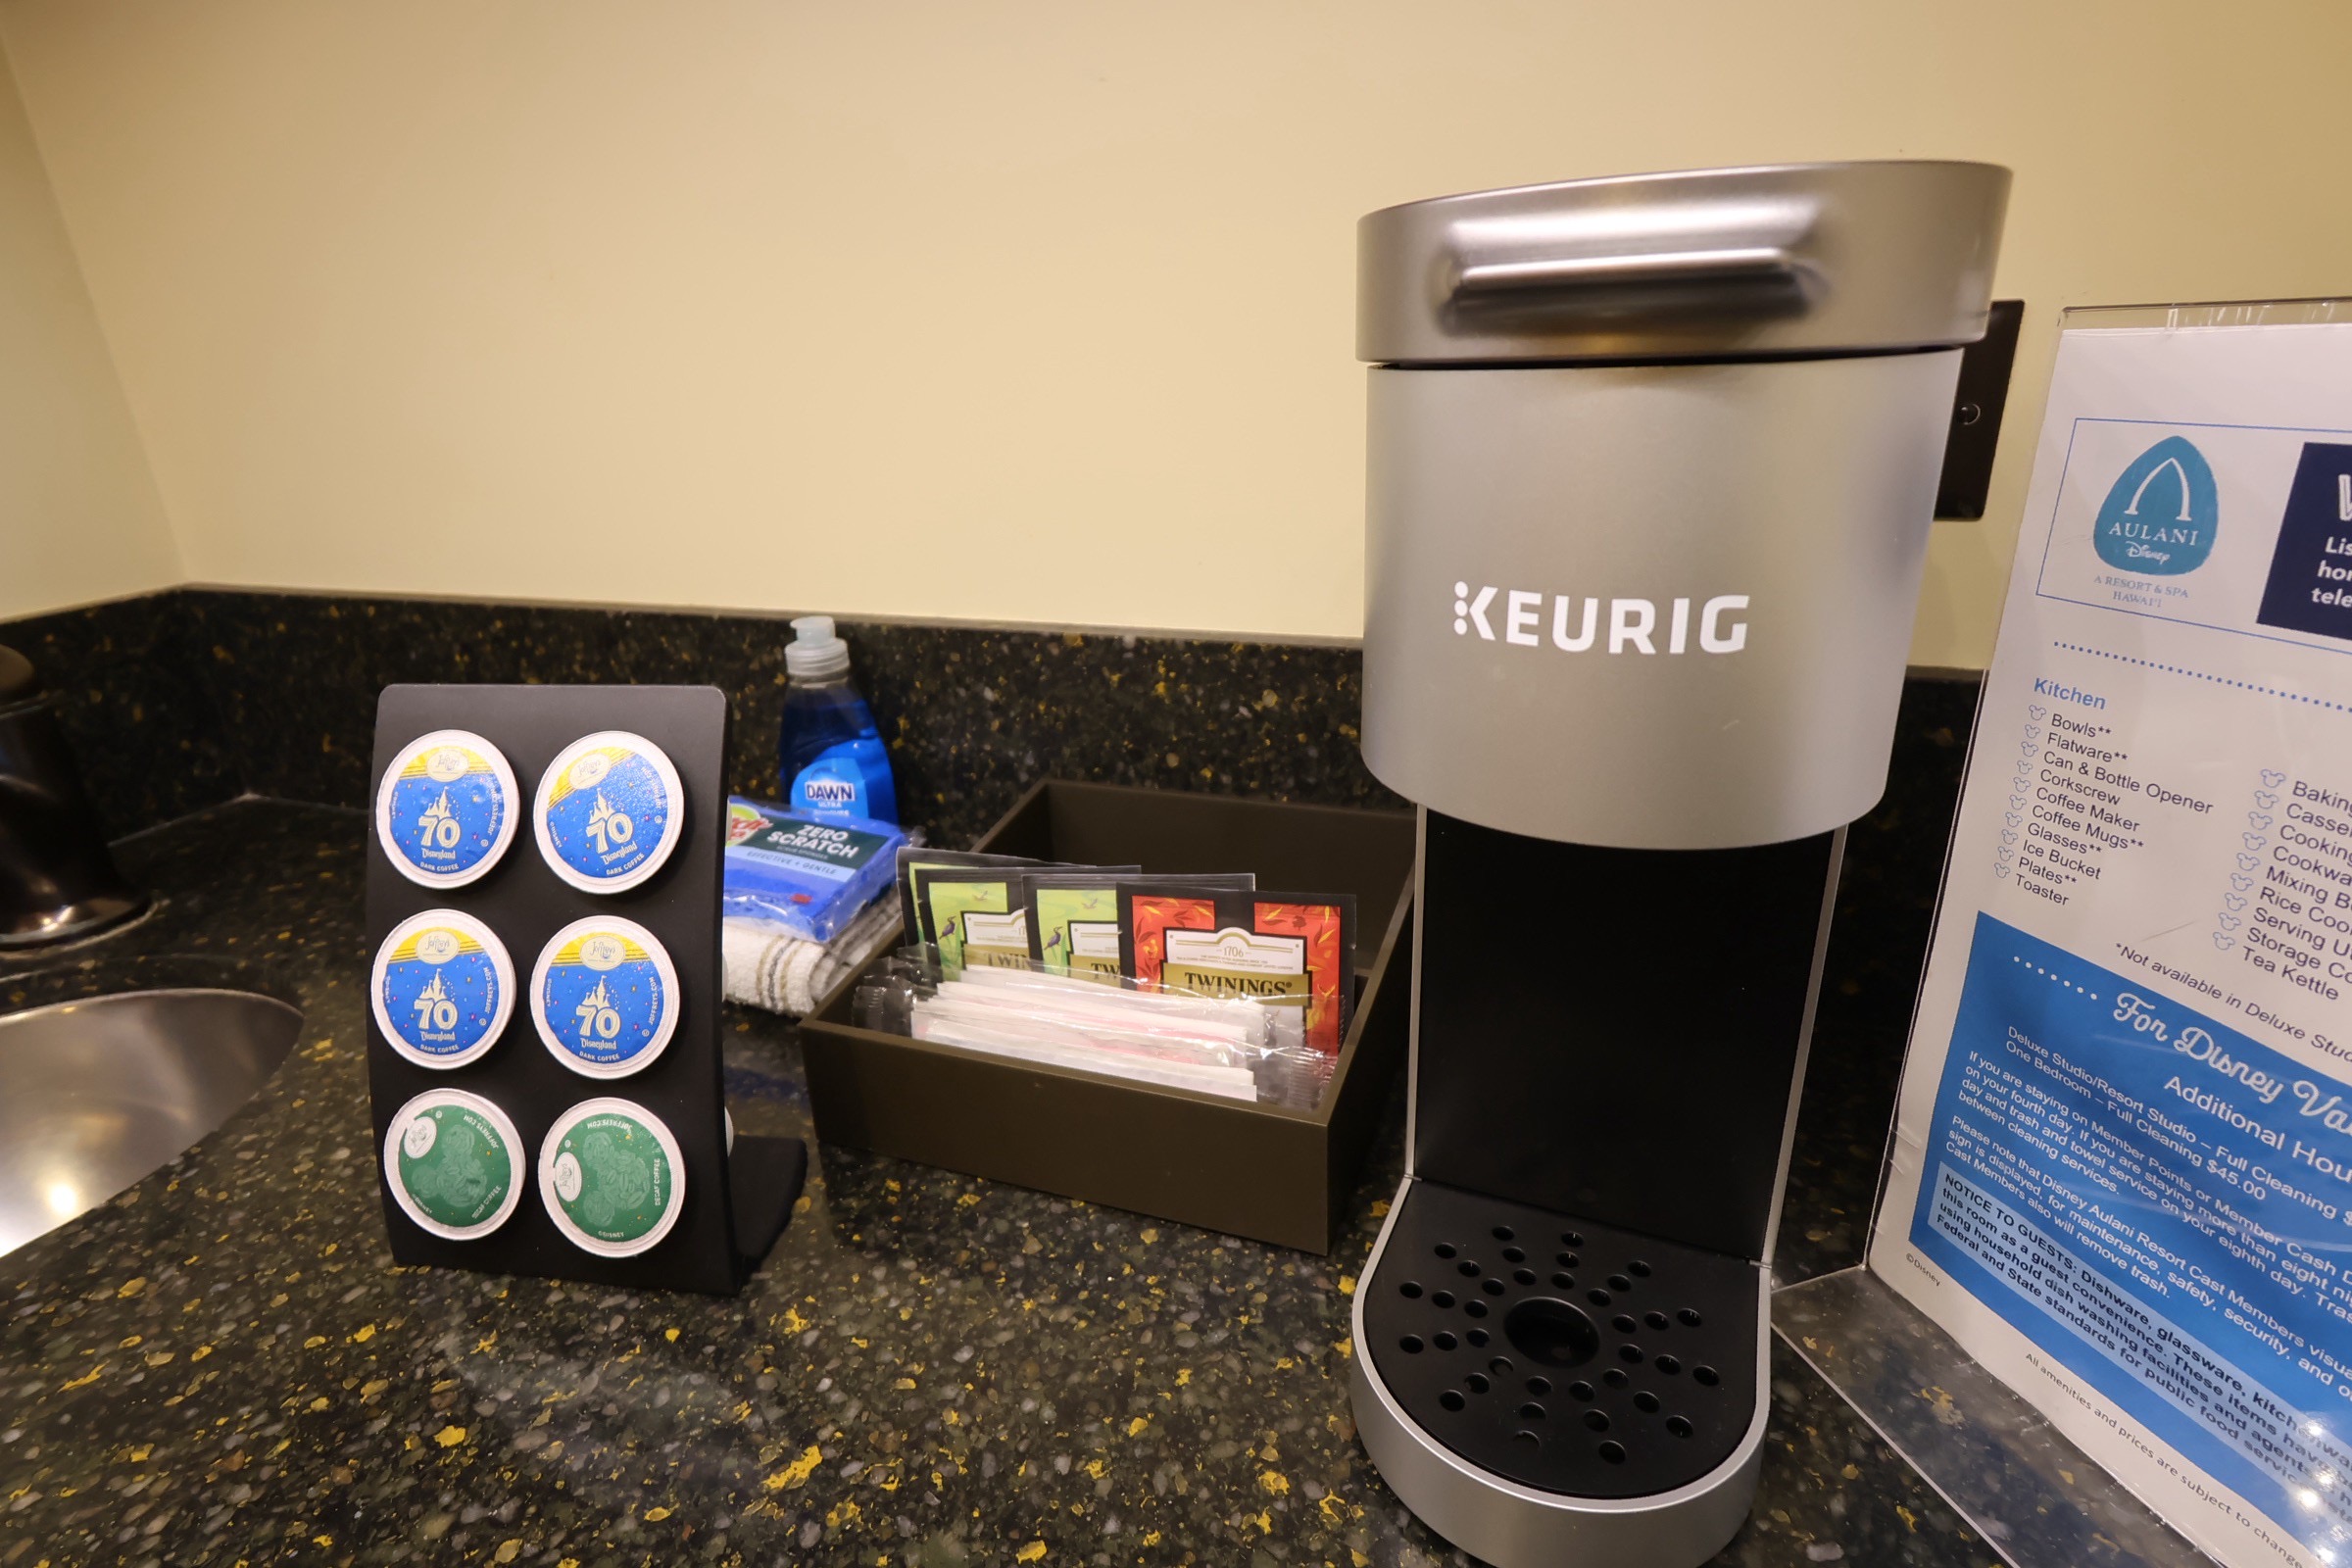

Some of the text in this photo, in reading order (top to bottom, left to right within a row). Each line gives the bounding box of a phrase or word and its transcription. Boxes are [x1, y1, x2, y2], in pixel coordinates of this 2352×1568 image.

[2109, 522, 2199, 546] AULANI
[2126, 541, 2170, 564] Disney
[2105, 576, 2152, 592] RESORT
[2154, 585, 2162, 594] &
[2166, 586, 2188, 598] SPA
[1454, 580, 1750, 655] KEURIG
[2034, 678, 2106, 710] Kitchen
[807, 784, 853, 800] DAWN
[2040, 769, 2121, 806] Corkscrew
[2044, 751, 2214, 813] Can & Bottle Opener
[2033, 805, 2081, 831] Coffee
[2036, 787, 2140, 832] Coffee Maker
[418, 815, 461, 849] 70
[586, 812, 633, 854] 70
[766, 831, 859, 858] SCRATCH
[796, 824, 849, 842] ZERO
[419, 862, 459, 872] DARK COFFEE
[421, 848, 457, 860] Disneyland
[600, 841, 637, 864] Disneyland
[623, 853, 645, 869] COFFEE
[747, 851, 792, 865] EFFECTIVE
[803, 862, 837, 874] GENTLE
[2023, 840, 2101, 880] Ice Bucket
[2016, 873, 2070, 906] Toaster
[2260, 886, 2301, 913] Rice
[2266, 866, 2328, 904] Mixing
[2254, 907, 2326, 951] Serving
[1223, 946, 1244, 957] 1706
[2247, 927, 2321, 969] Storage
[2243, 945, 2338, 1000] Tea Kettle
[414, 999, 459, 1030] 70
[2151, 960, 2222, 999] available
[2225, 994, 2241, 1008] in
[2244, 1003, 2305, 1040] Deluxe
[419, 1031, 456, 1041] Disneyland
[576, 1005, 621, 1039] 70
[438, 1045, 460, 1054] COFFEE
[579, 1051, 596, 1060] DARK
[580, 1038, 616, 1050] Disneyland
[2113, 993, 2168, 1041] For
[2173, 1027, 2283, 1103] Disney
[2006, 1041, 2267, 1200] One Bedroom Full Cleaning $45.00
[2009, 1026, 2337, 1219] Deluxe Studio/Resort Studio Full Cleaning
[2164, 1076, 2285, 1151] Additional
[1958, 1090, 2119, 1195] between cleaning services.
[1978, 1057, 2337, 1276] you are staying on Member Points Member Cash
[1946, 1142, 2170, 1298] Cast Members also will remove trash.
[1952, 1115, 2304, 1348] Please note that Disney Aulani Resort Cast Members
[1948, 1130, 1972, 1150] sign
[2048, 1195, 2066, 1211] for
[2069, 1210, 2161, 1275] maintenance,
[2168, 1271, 2217, 1311] safety,
[2225, 1308, 2290, 1360] security,
[2298, 1358, 2333, 1386] and
[1945, 1174, 2246, 1396] NOTICE TO GUESTS: Dishware, glassware,
[1936, 1214, 2238, 1440] Federal and State standards for public food
[1940, 1202, 2247, 1430] using household dish washing facilities and
[1942, 1188, 1963, 1208] this
[1966, 1206, 1997, 1234] room
[2032, 1252, 2069, 1284] guest
[2073, 1282, 2167, 1357] convenience.
[2174, 1352, 2224, 1396] These
[2229, 1394, 2277, 1436] items
[2026, 1353, 2038, 1367] All
[2040, 1366, 2091, 1410] amenities
[2094, 1408, 2118, 1429] and
[2119, 1427, 2154, 1459] prices
[2157, 1457, 2179, 1477] are
[2180, 1476, 2232, 1515] subject
[2236, 1512, 2250, 1528] to
